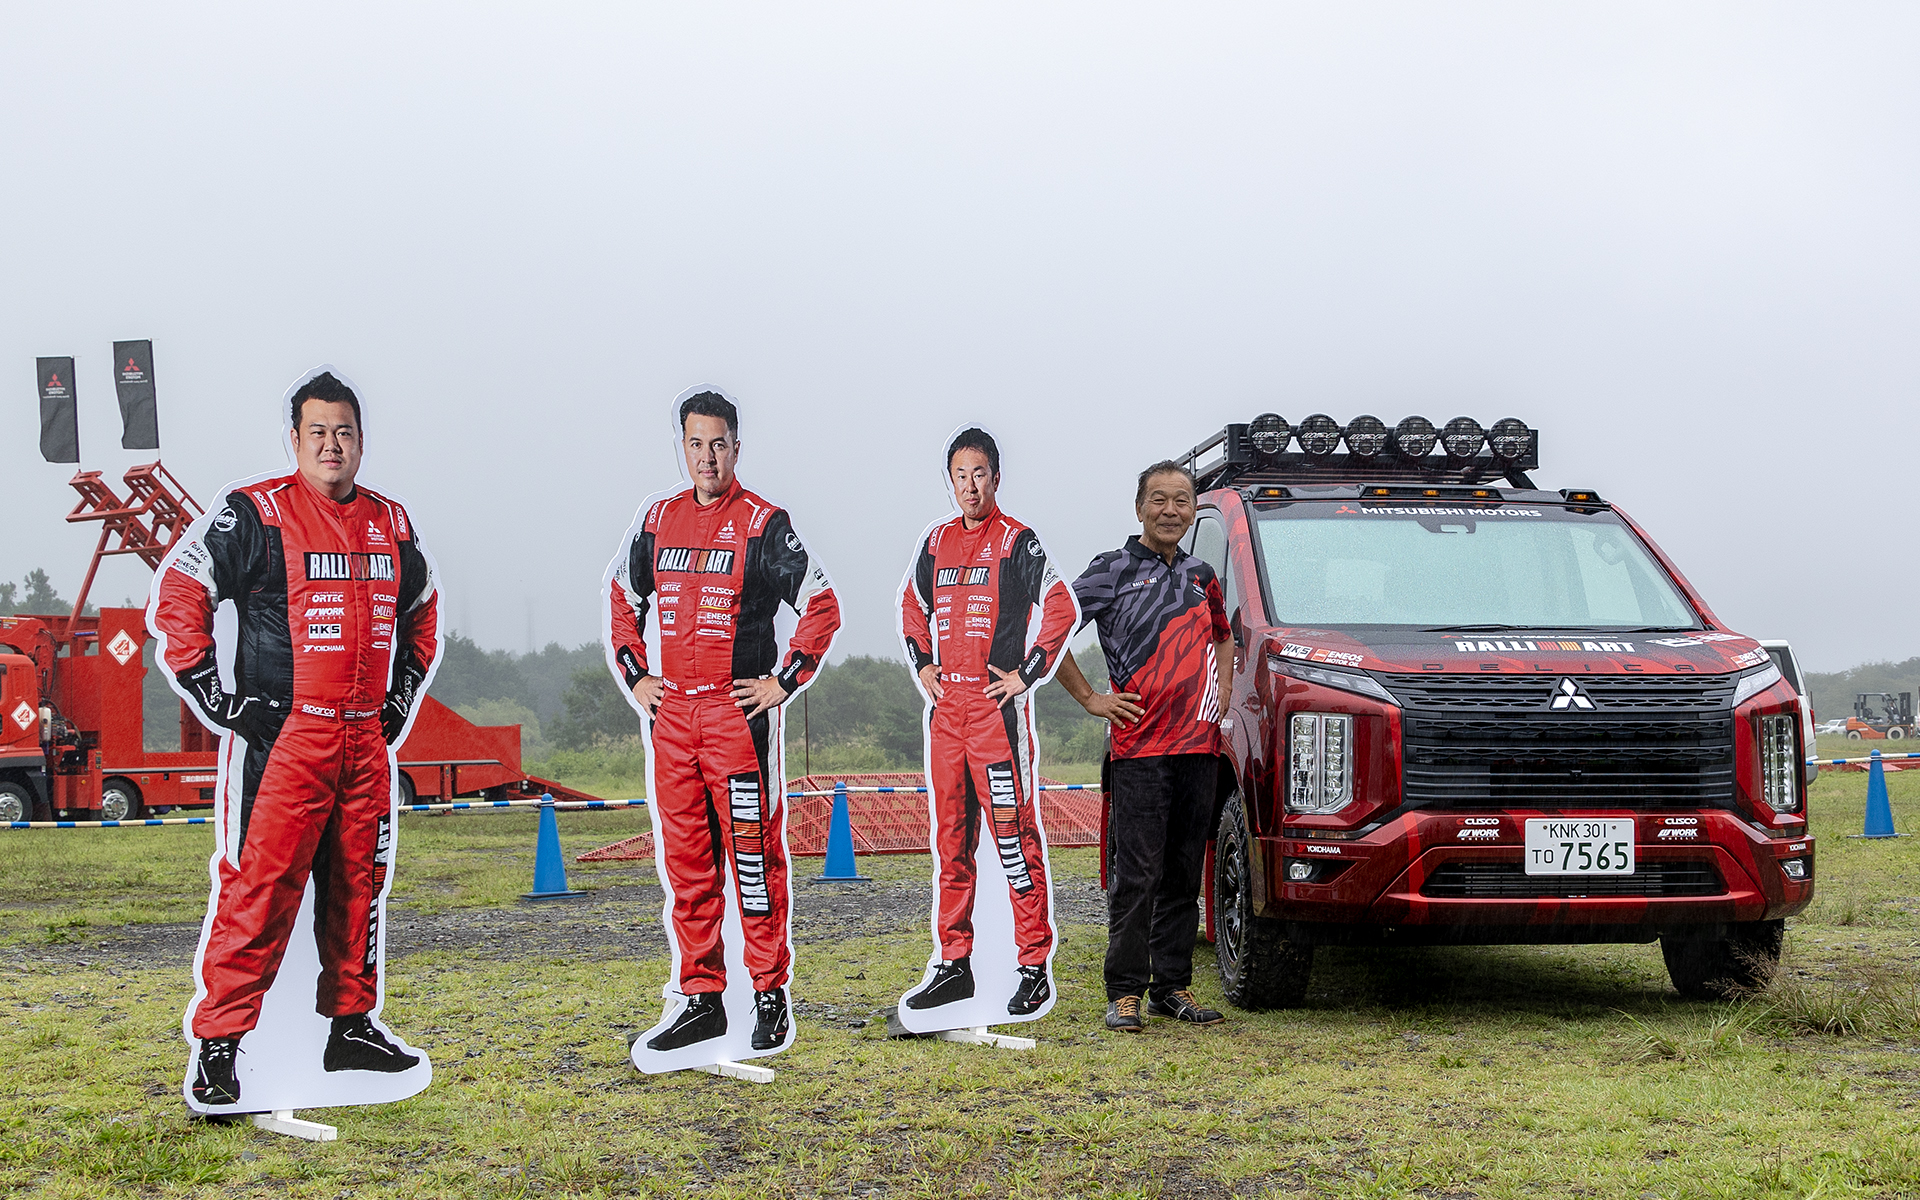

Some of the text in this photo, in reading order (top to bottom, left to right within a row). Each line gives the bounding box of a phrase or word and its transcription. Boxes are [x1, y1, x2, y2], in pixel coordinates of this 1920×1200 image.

[252, 491, 274, 518] sparco
[1361, 506, 1542, 518] MITSUBISHI MOTORS
[309, 553, 393, 579] RALLI ART
[658, 548, 734, 573] RALLI ART
[937, 567, 988, 587] RALLI ART
[311, 593, 344, 603] ORTEC
[700, 595, 733, 608] ENDLESS
[706, 612, 732, 621] ENEOS
[309, 625, 341, 634] HKS
[1283, 644, 1311, 655] HKS
[1454, 641, 1636, 653] RALLI ART
[1325, 657, 1349, 666] MOTOR
[1328, 650, 1364, 663] ENEOS
[1422, 662, 1696, 672] DELICA
[301, 704, 336, 718] sparco
[1664, 817, 1698, 825] CUSCO
[988, 767, 1031, 891] RALLI ART
[1549, 823, 1608, 839] KNK 301
[731, 778, 770, 912] RALLI ART
[1306, 845, 1342, 854] YOKOHAMA
[1531, 842, 1629, 871] TO 7565
